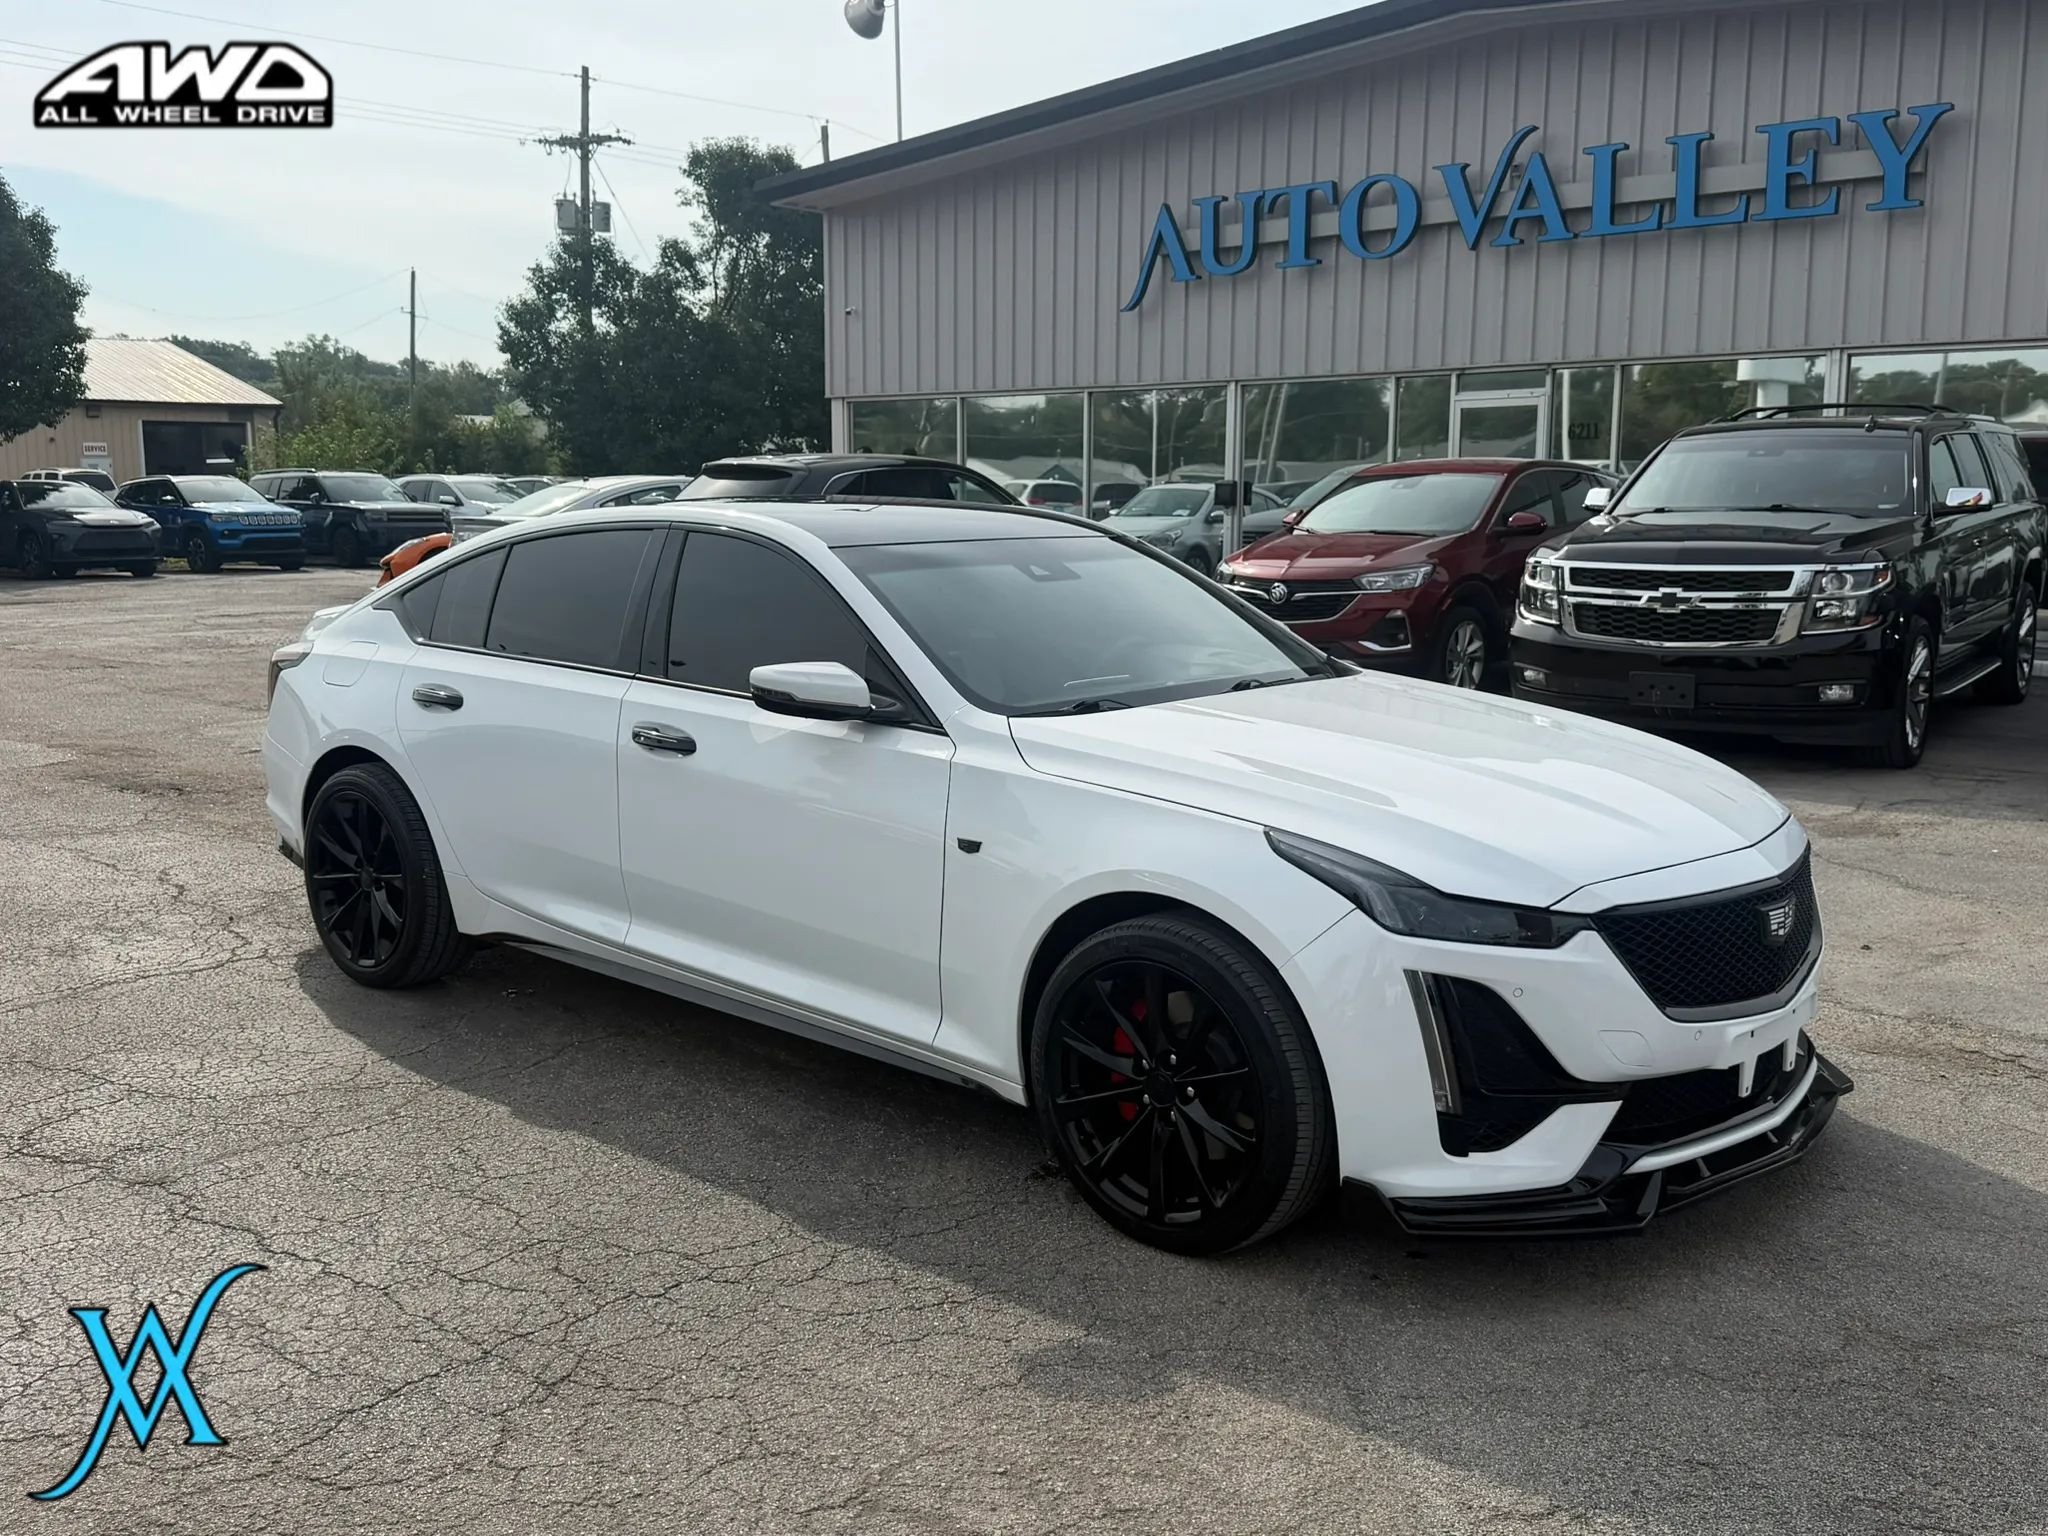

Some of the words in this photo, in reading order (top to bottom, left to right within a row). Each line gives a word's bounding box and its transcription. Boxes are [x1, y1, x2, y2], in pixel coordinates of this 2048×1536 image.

[1120, 173, 1421, 312] AUTO
[1433, 102, 1955, 251] VALLEY
[1568, 422, 1600, 440] 6211
